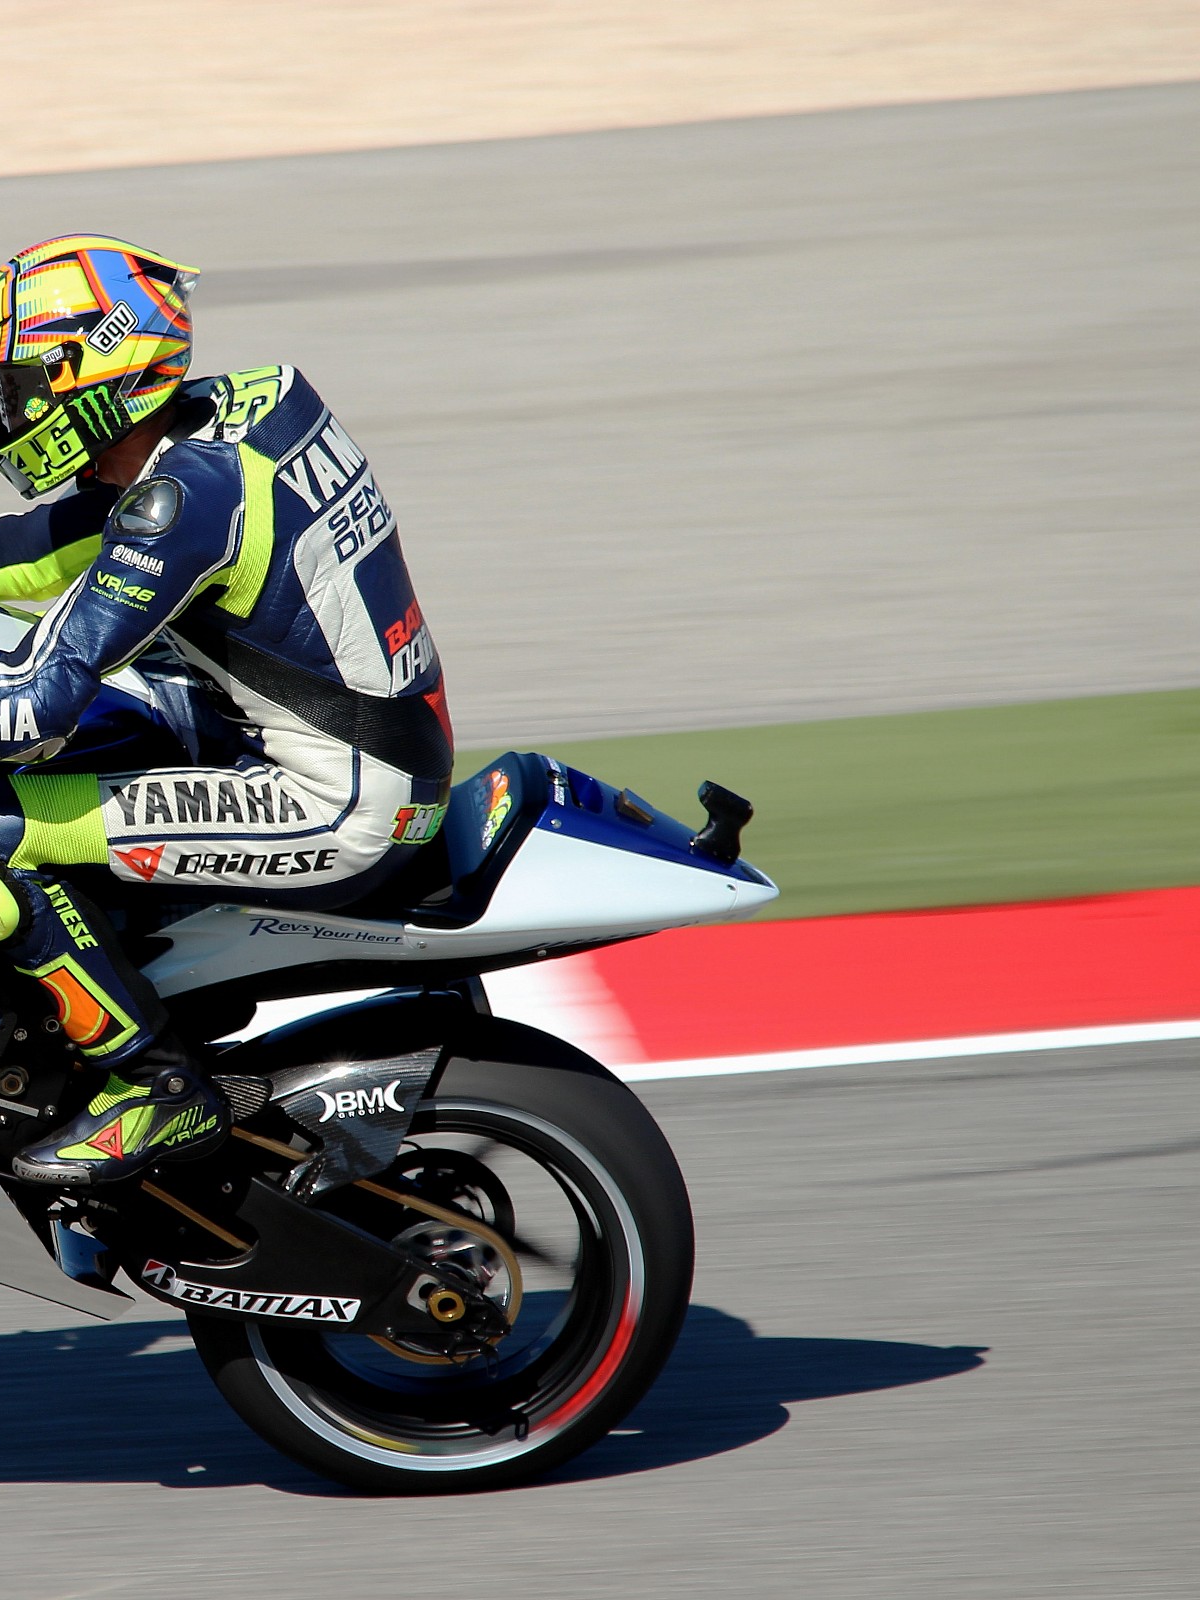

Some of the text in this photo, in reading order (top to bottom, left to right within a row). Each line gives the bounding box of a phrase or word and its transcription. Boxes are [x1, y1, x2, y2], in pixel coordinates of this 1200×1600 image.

[97, 309, 131, 348] agv
[8, 413, 84, 480] 46
[120, 547, 165, 574] YAMAHA
[90, 586, 149, 612] RACING APPAREL
[109, 780, 308, 826] YAMAHA
[338, 1107, 385, 1119] GROUP
[180, 1283, 358, 1321] BATTLAX
